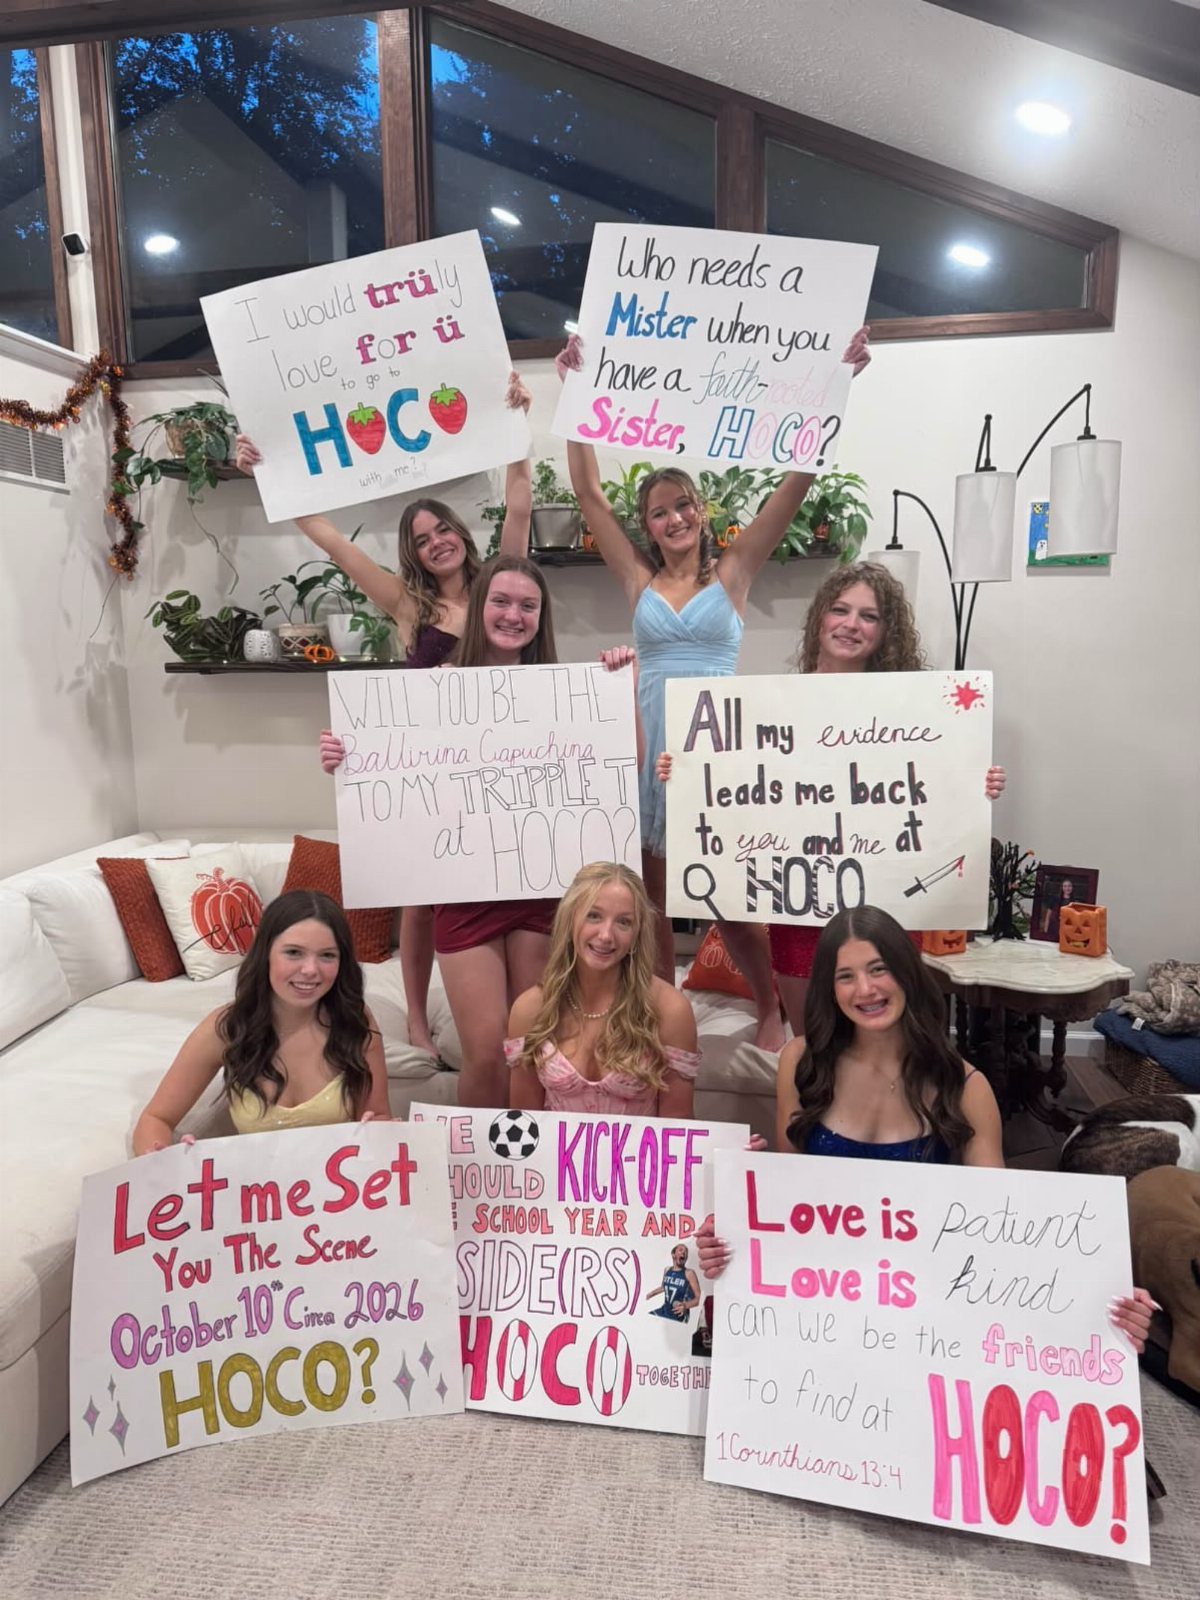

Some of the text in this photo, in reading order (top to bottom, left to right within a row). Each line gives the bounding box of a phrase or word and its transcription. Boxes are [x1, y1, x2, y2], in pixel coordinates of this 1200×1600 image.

[617, 236, 804, 294] Who needs a
[235, 260, 464, 343] I would trüly
[605, 290, 830, 362] Mister when you
[271, 315, 465, 391] love for ü
[341, 366, 401, 390] to go to
[594, 346, 656, 392] have
[664, 367, 692, 392] a
[577, 396, 841, 467] Sister, HOCO?
[359, 456, 416, 487] with me?
[333, 665, 617, 730] WILL YOU BE THE
[683, 690, 943, 755] All my evidence
[340, 728, 595, 776] Ballirina Capuchina
[704, 761, 927, 808] leads me back
[344, 757, 636, 822] TO MY TRIPPLE T
[433, 809, 475, 860] at
[695, 810, 923, 862] to you and me at
[746, 856, 865, 918] HOCO
[448, 1162, 545, 1200] HOULD
[557, 1121, 709, 1210] KICK-OFF
[113, 1142, 418, 1255] Let me Set
[472, 1203, 554, 1234] SCHOOL
[564, 1207, 628, 1237] YEAR
[641, 1211, 696, 1239] AND
[746, 1170, 1102, 1256] Love is patient
[153, 1224, 378, 1293] You The Scene
[750, 1238, 1075, 1315] Love is kind
[111, 1300, 238, 1369] October
[284, 1286, 335, 1330] Circa
[344, 1278, 424, 1329] 2026
[727, 1302, 1127, 1386] can we be the friends
[159, 1336, 380, 1448] HOCO?
[459, 1315, 632, 1417] HOCO
[744, 1365, 1141, 1545] to find at HOCO?
[861, 1460, 902, 1491] 13:4
